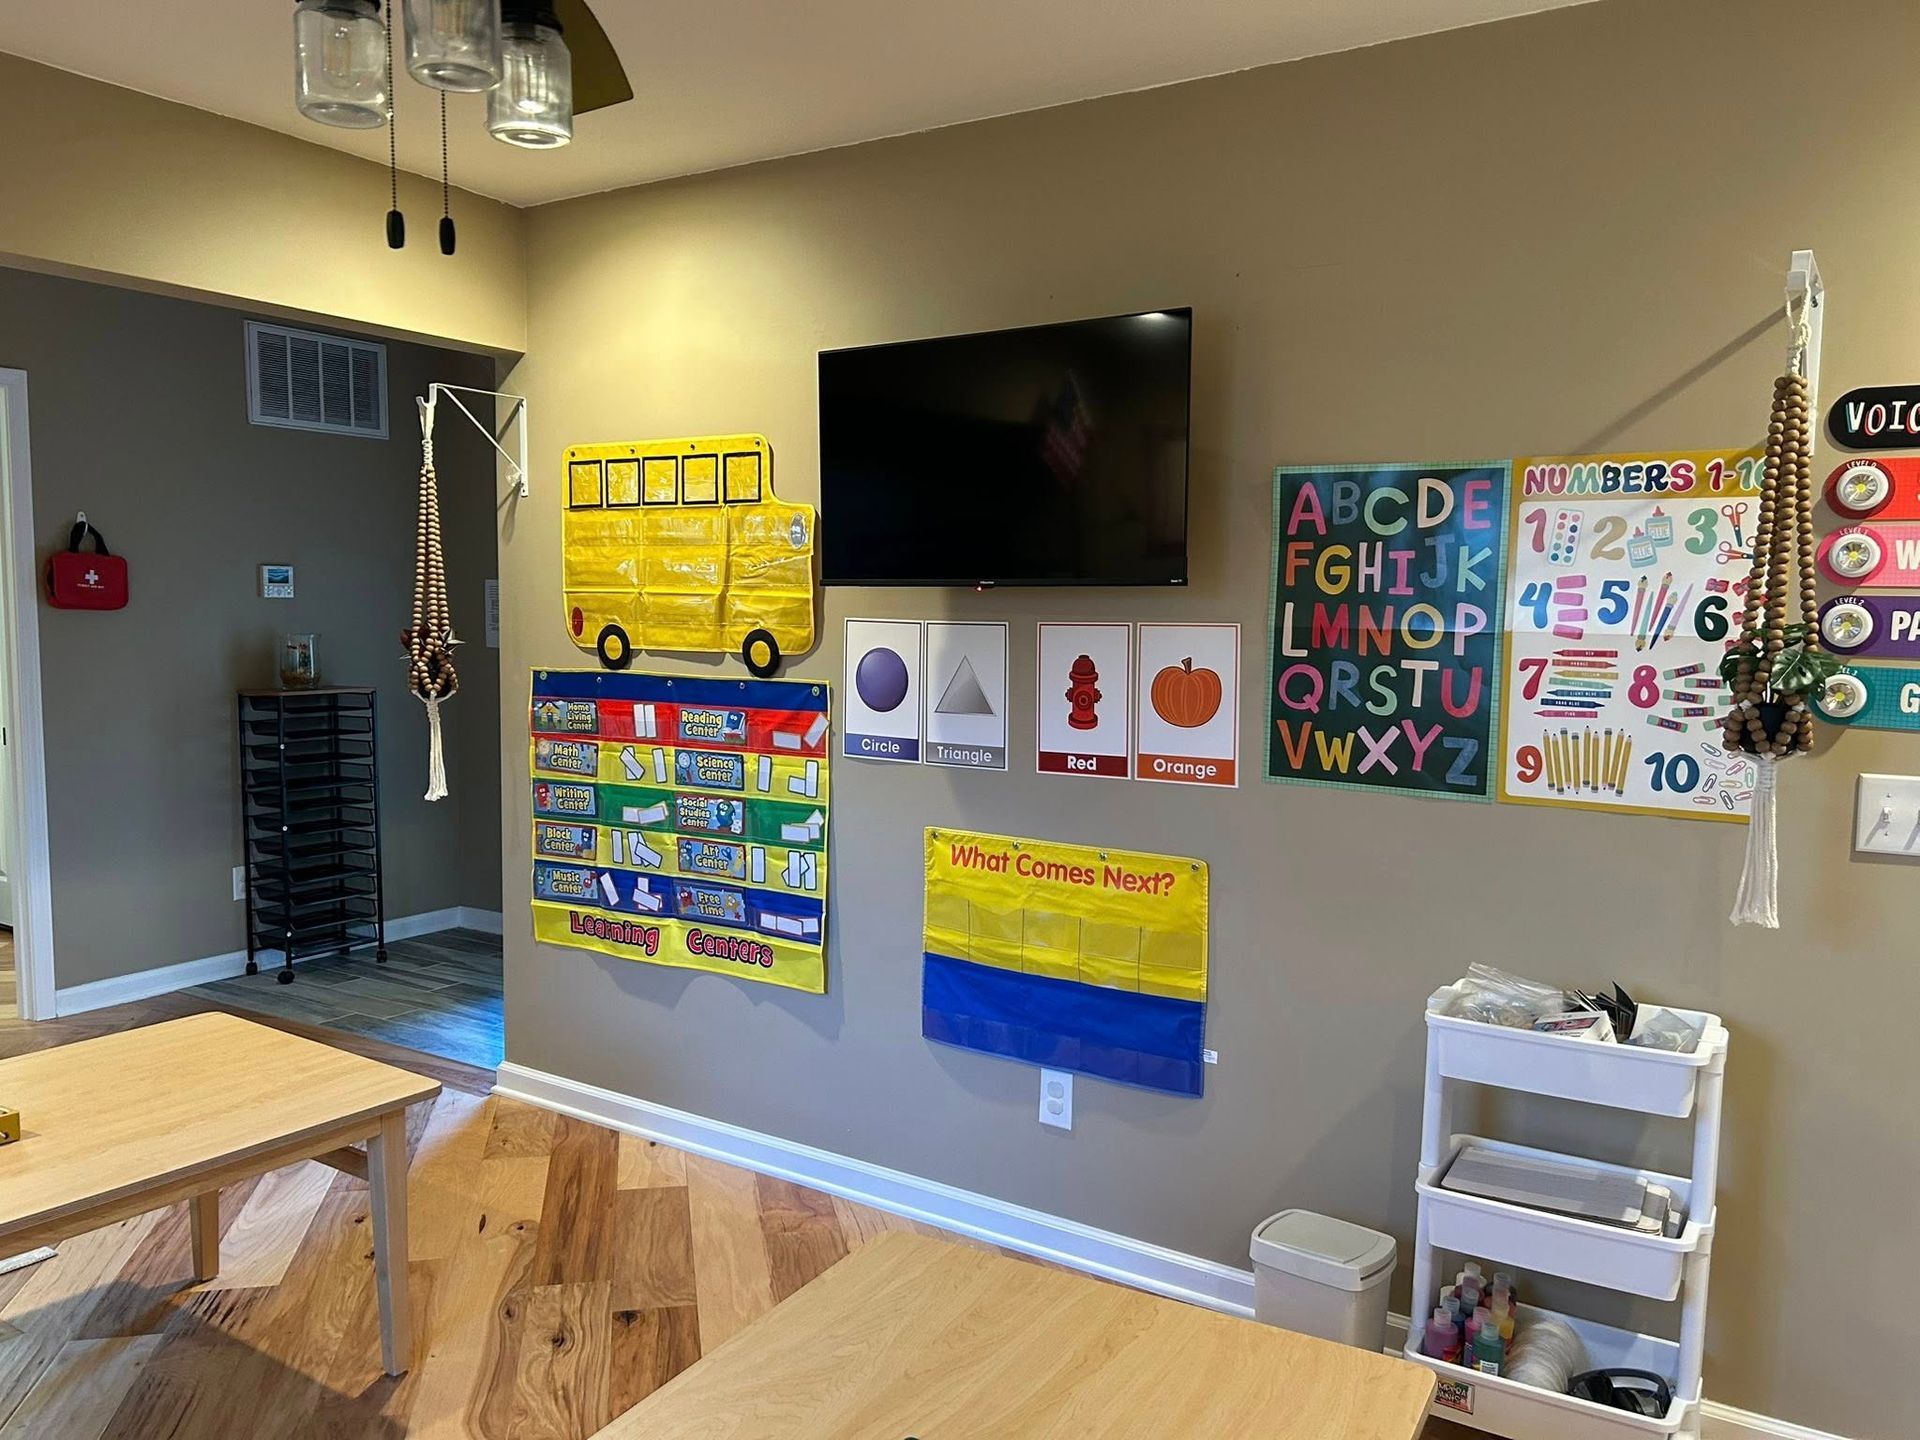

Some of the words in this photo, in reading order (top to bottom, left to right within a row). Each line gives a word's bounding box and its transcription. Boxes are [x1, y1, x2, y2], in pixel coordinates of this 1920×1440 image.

[1525, 462, 1694, 493] NUMBERS
[1525, 508, 1547, 552] 1
[1685, 507, 1718, 555] 3
[1840, 527, 1862, 535] LEVEL
[1590, 515, 1627, 560] 2
[1519, 582, 1552, 629] 4
[1598, 580, 1630, 625] 5
[1835, 597, 1857, 605] LEVEL
[1858, 599, 1865, 607] 2
[1694, 596, 1728, 642] 6
[1519, 658, 1548, 700] 7
[1628, 665, 1660, 709] 8
[567, 702, 590, 711] Home
[567, 712, 592, 723] Living
[681, 710, 722, 728] Reading
[567, 722, 593, 730] Center
[685, 724, 719, 737] Center
[554, 744, 579, 757] Math
[861, 738, 901, 754] Circle
[936, 745, 993, 764] Triangle
[550, 756, 582, 769] Center
[697, 756, 734, 770] Science
[1066, 756, 1097, 771] Red
[1153, 758, 1217, 778] Orange
[1516, 745, 1543, 782] 9
[699, 769, 732, 782] Center
[1645, 751, 1700, 793] 10
[554, 787, 590, 799] Writing
[557, 799, 589, 811] Center
[682, 798, 708, 808] Social
[680, 808, 711, 818] Studies
[681, 818, 709, 828] Center
[546, 828, 572, 840] Block
[544, 840, 575, 852] Center
[702, 844, 720, 857] Art
[695, 854, 728, 870] Center
[552, 870, 580, 882] Music
[951, 843, 1010, 873] What
[1015, 854, 1095, 885] Comes
[1103, 864, 1176, 897] Next?
[552, 882, 583, 895] Center
[697, 891, 721, 905] Free
[697, 903, 725, 917] Time
[570, 911, 660, 956] Learning
[687, 928, 774, 968] Centers
